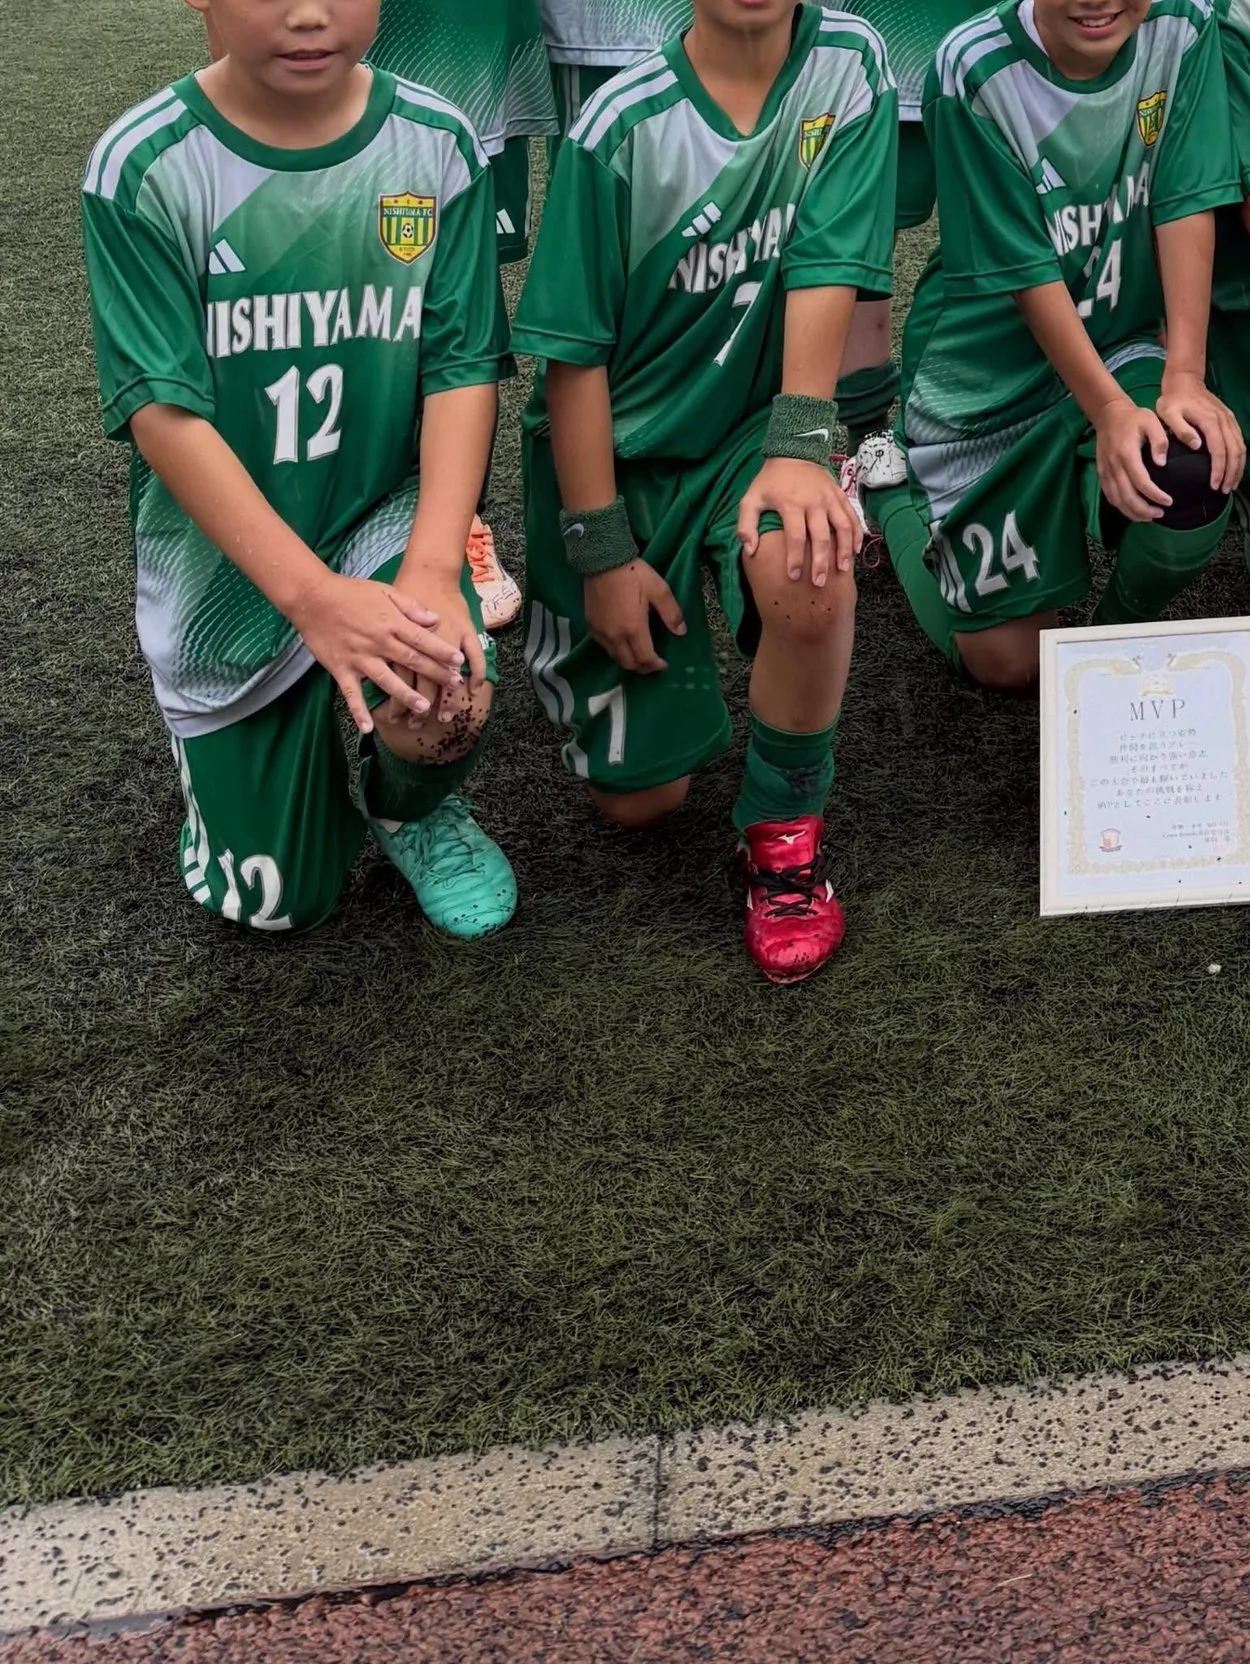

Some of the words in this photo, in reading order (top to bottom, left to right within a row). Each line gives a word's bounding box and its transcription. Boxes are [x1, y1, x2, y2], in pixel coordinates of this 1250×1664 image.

[712, 281, 764, 367] 7
[264, 363, 344, 465] 12
[963, 510, 1040, 598] 24
[588, 685, 627, 766] 7
[1129, 698, 1185, 722] MVP
[217, 847, 294, 931] 12
